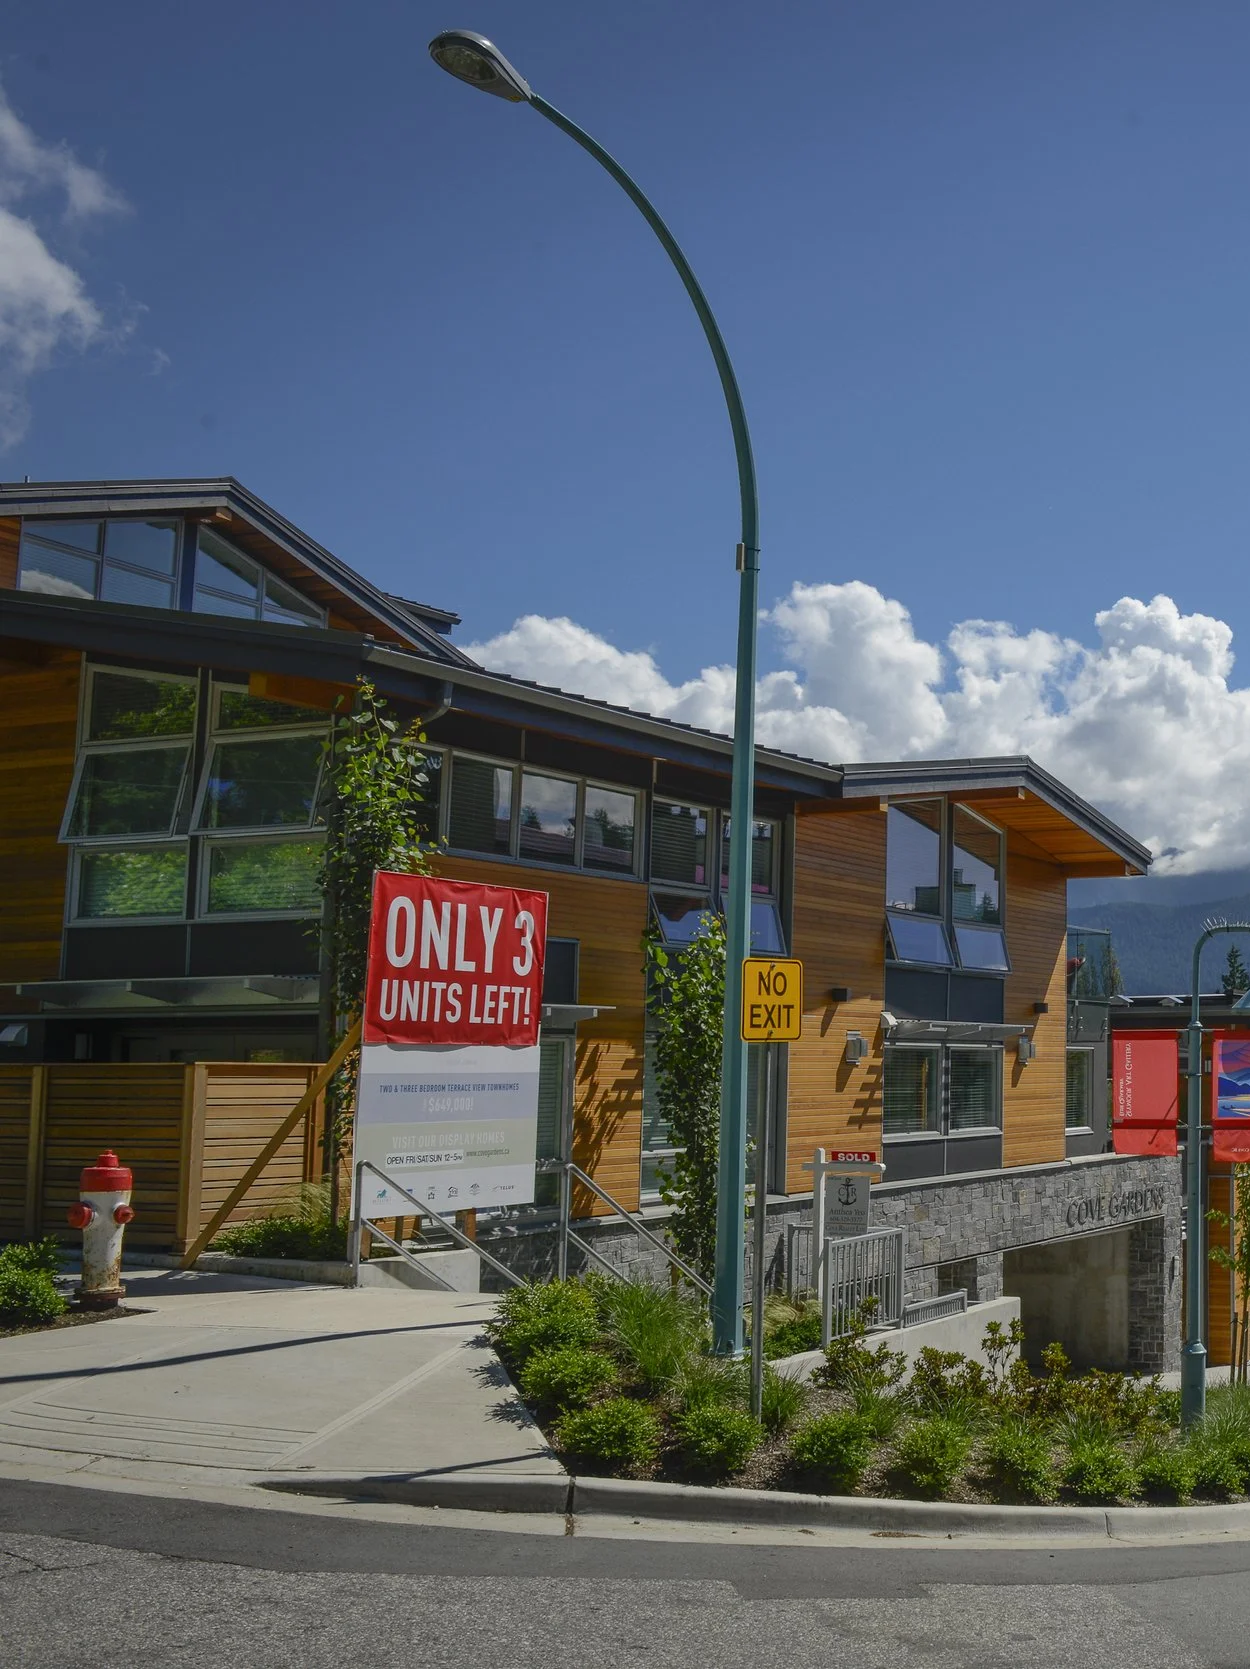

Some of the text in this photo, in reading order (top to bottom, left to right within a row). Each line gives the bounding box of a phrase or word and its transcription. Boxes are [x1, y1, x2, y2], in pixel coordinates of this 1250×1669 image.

[385, 896, 535, 977] ONLY 3
[758, 971, 787, 996] NO
[379, 978, 532, 1025] UNITS LEFT!
[750, 1004, 795, 1028] EXIT
[380, 1083, 520, 1093] TWO & THREE BEDROOM TERRACE VIEW TOWNHOMES
[392, 1131, 506, 1149] VISIT OUR DISPLAY HOMES
[387, 1156, 404, 1165] OPEN
[837, 1153, 870, 1161] SOLD
[1066, 1186, 1165, 1228] COVE GARDENS
